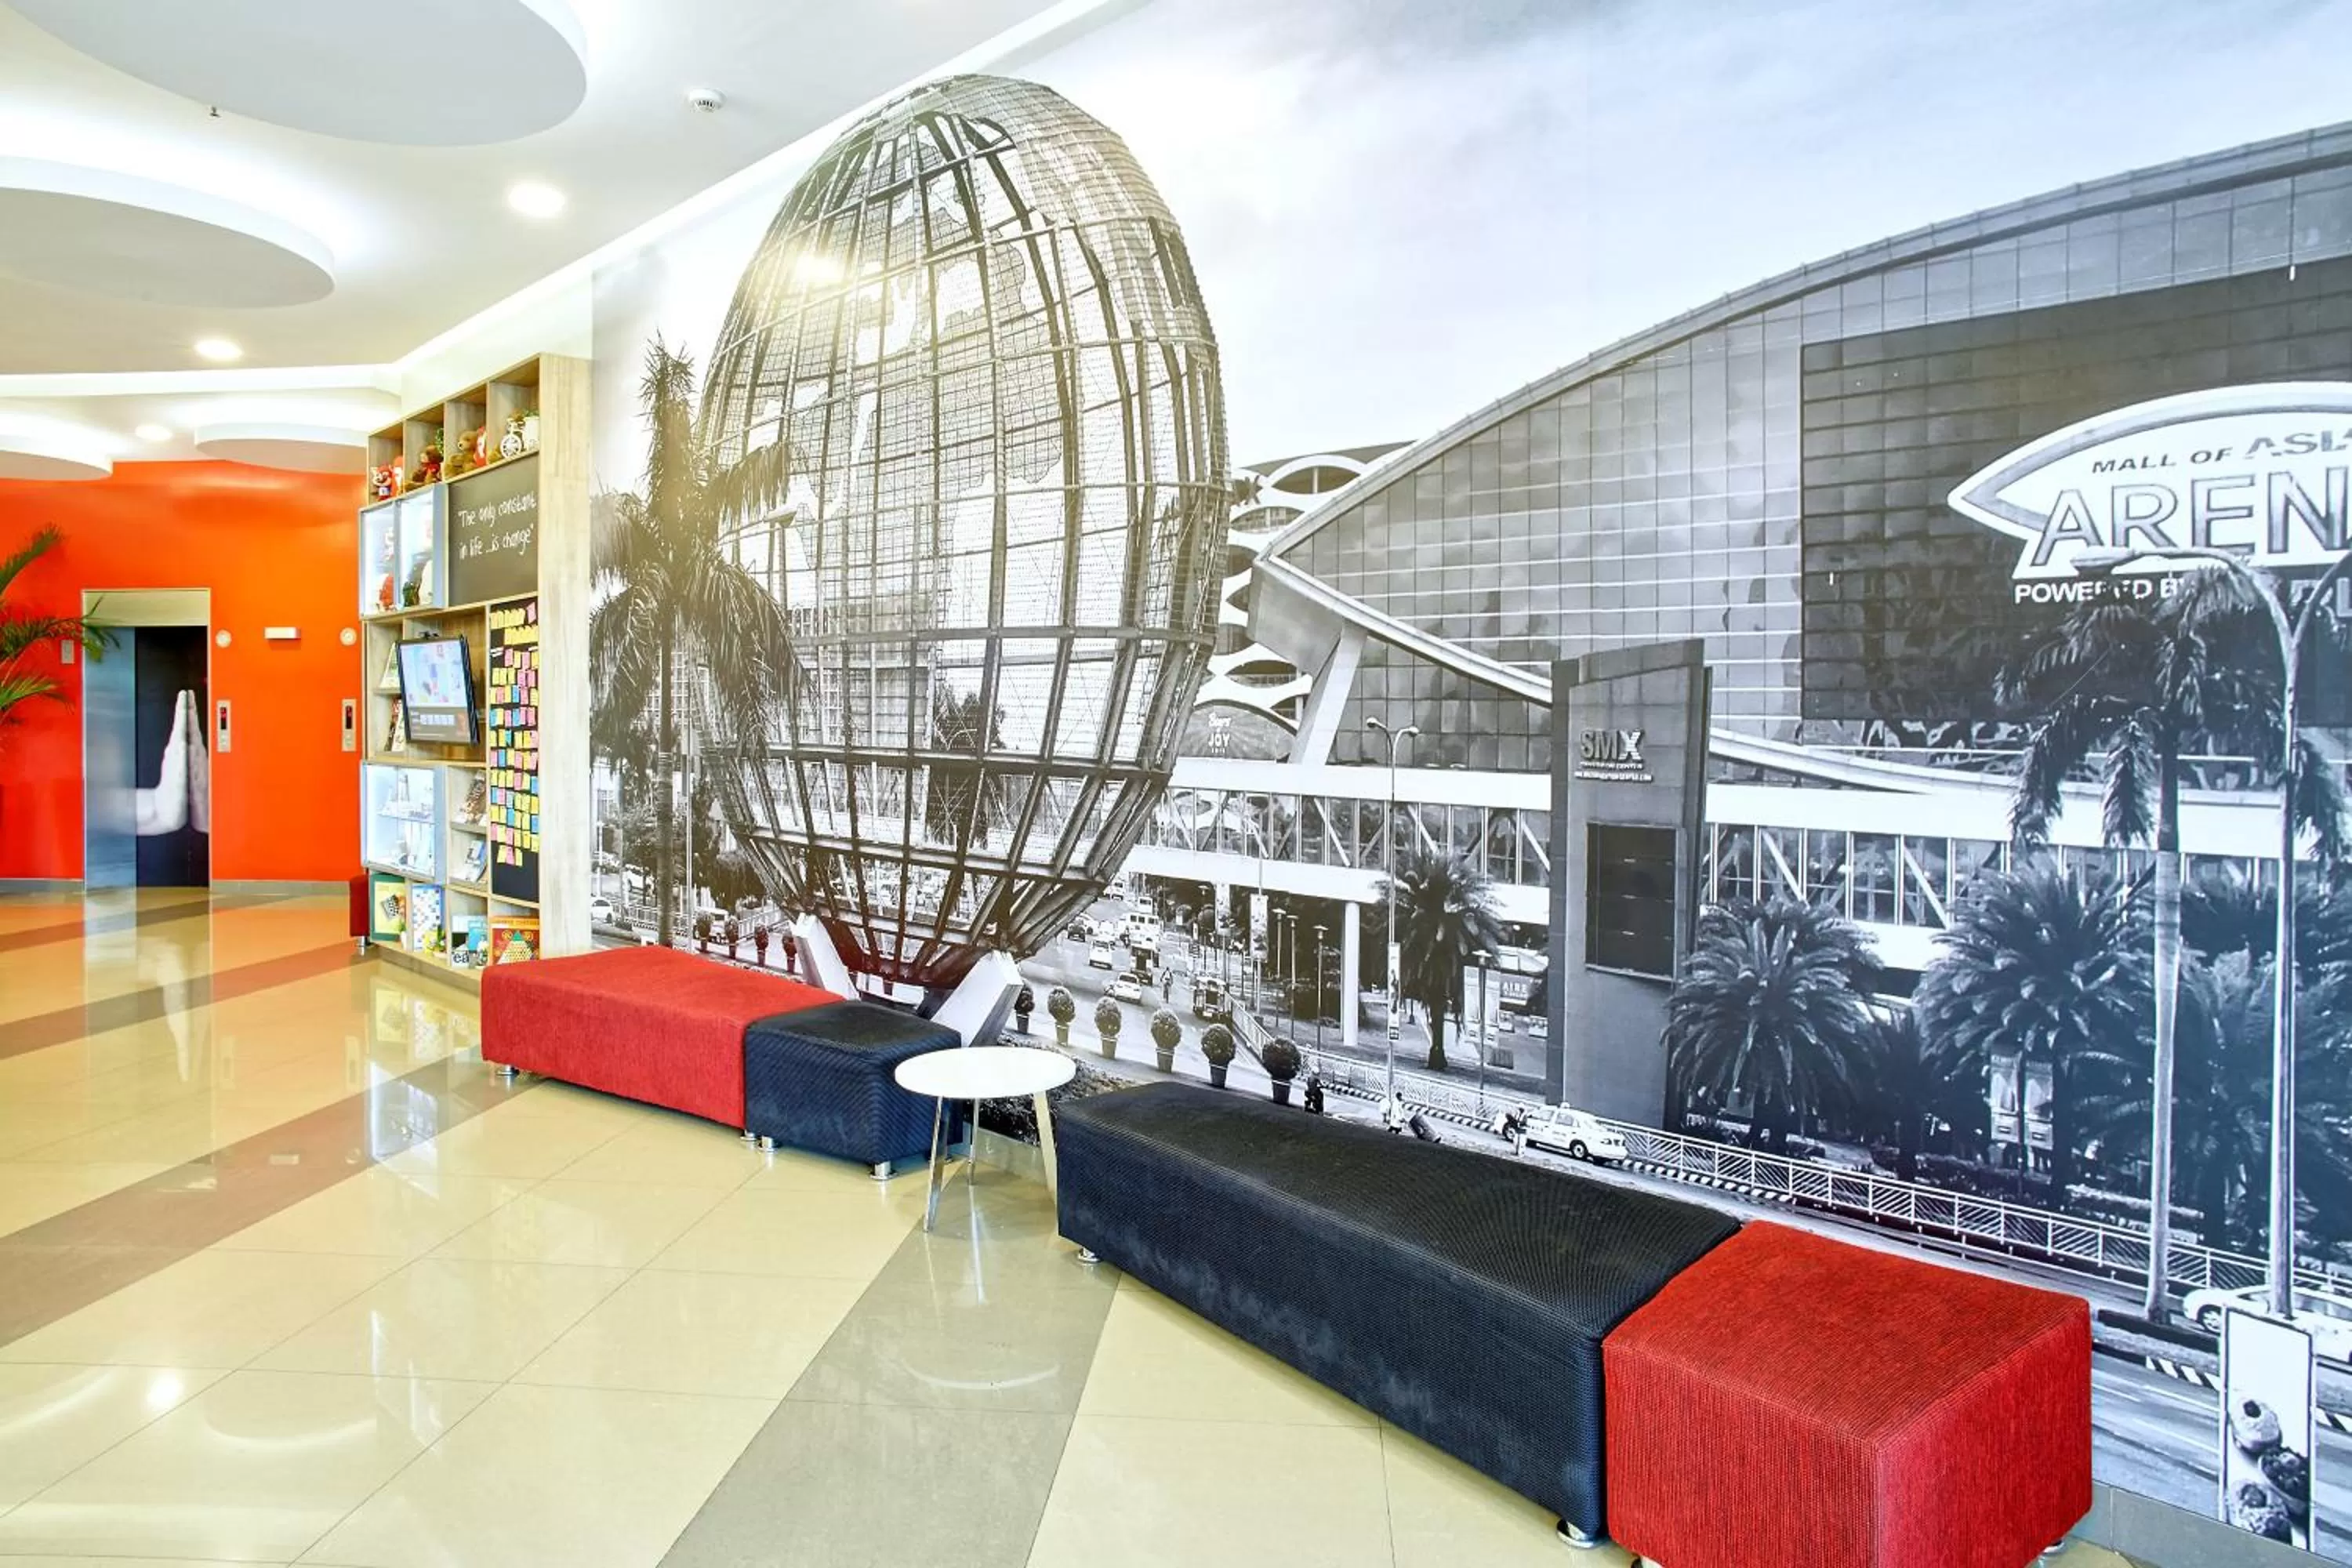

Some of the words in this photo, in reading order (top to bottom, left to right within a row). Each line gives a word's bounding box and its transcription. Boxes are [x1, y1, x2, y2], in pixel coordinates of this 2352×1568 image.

[2092, 453, 2176, 474] MALL
[2190, 447, 2233, 464] OF
[479, 502, 495, 528] only
[498, 491, 537, 517] constant
[2031, 466, 2349, 567] AREN
[459, 542, 468, 560] in
[470, 535, 483, 557] life
[1581, 728, 1643, 760] SMX
